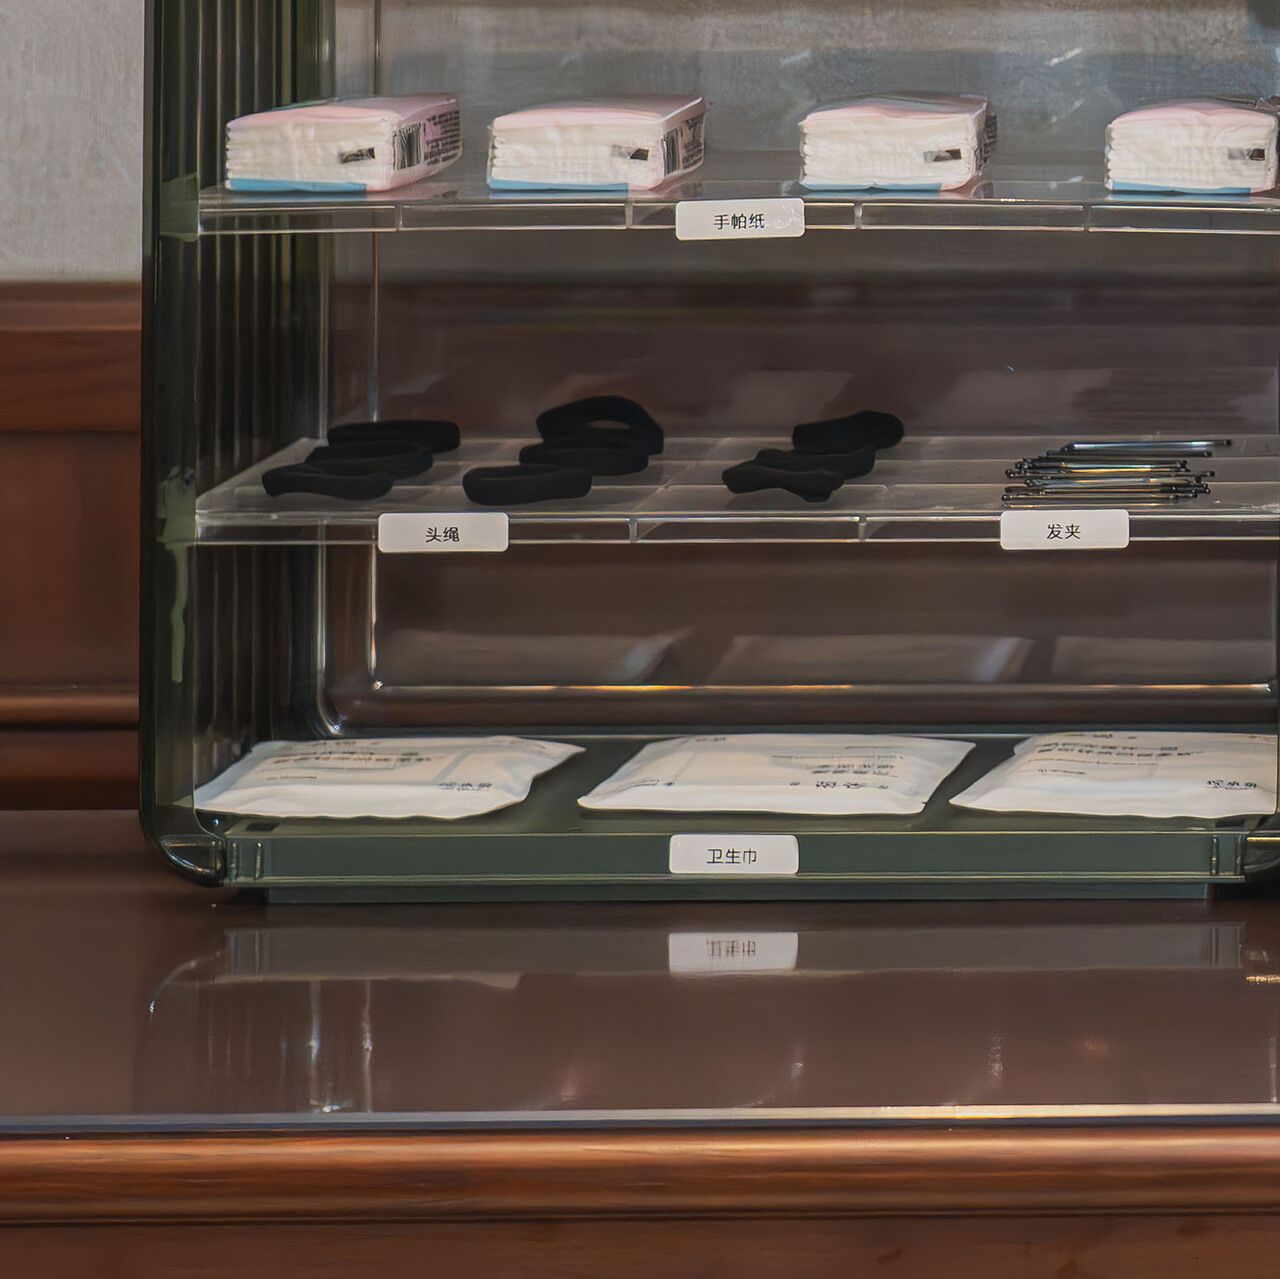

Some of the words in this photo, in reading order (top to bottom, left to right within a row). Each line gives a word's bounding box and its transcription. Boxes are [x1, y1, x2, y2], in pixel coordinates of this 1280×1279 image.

[713, 213, 765, 231] 手帕纸
[425, 526, 460, 543] 头绳
[1046, 523, 1081, 540] 发夹
[706, 847, 757, 865] 卫生巾
